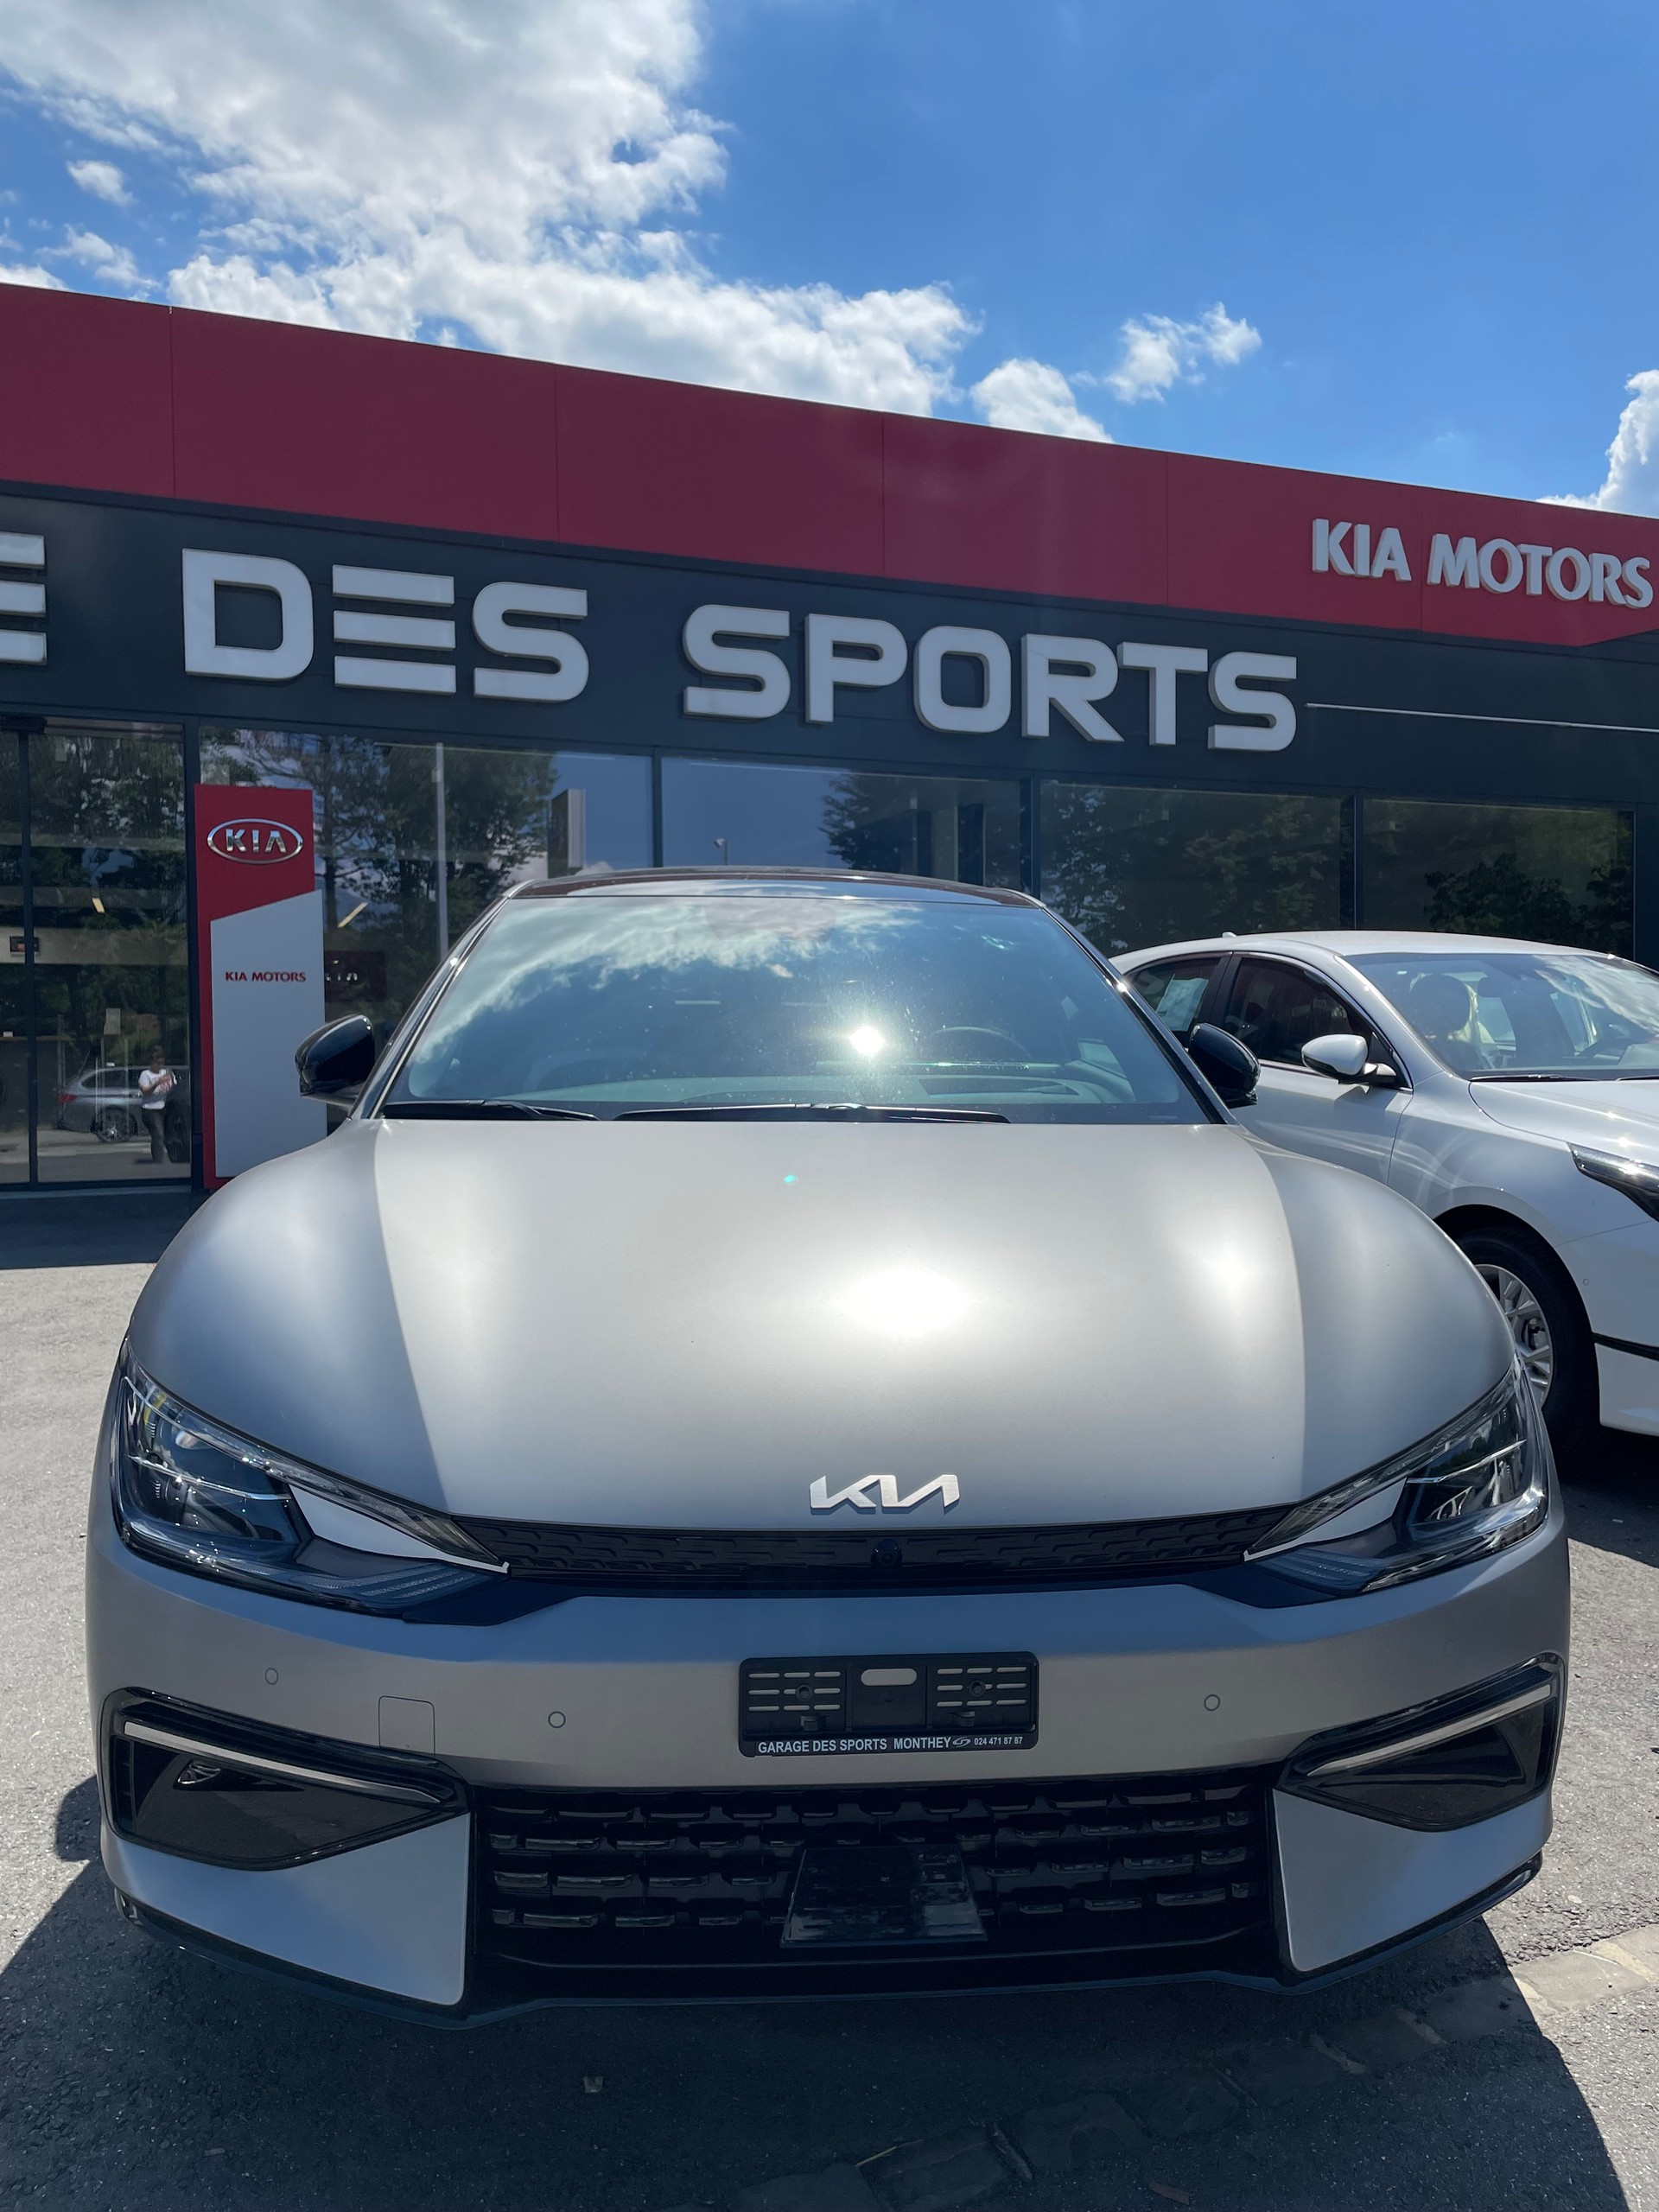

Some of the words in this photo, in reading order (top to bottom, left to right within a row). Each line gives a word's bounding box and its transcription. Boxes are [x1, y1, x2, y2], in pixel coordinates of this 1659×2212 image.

[1312, 518, 1412, 582] KIA
[1427, 533, 1654, 608] MOTORS
[182, 548, 589, 703] DES
[683, 604, 1297, 752] SPORTS
[226, 829, 287, 853] KIA
[225, 971, 248, 982] KIA
[251, 971, 307, 983] MOTORS
[810, 1474, 960, 1509] KIA
[758, 1740, 810, 1754] GARAGE
[812, 1739, 836, 1751] DES
[839, 1738, 887, 1751] SPORTS
[893, 1736, 951, 1750] MONTHEY
[974, 1737, 987, 1745] 024
[1014, 1736, 1024, 1745] 87
